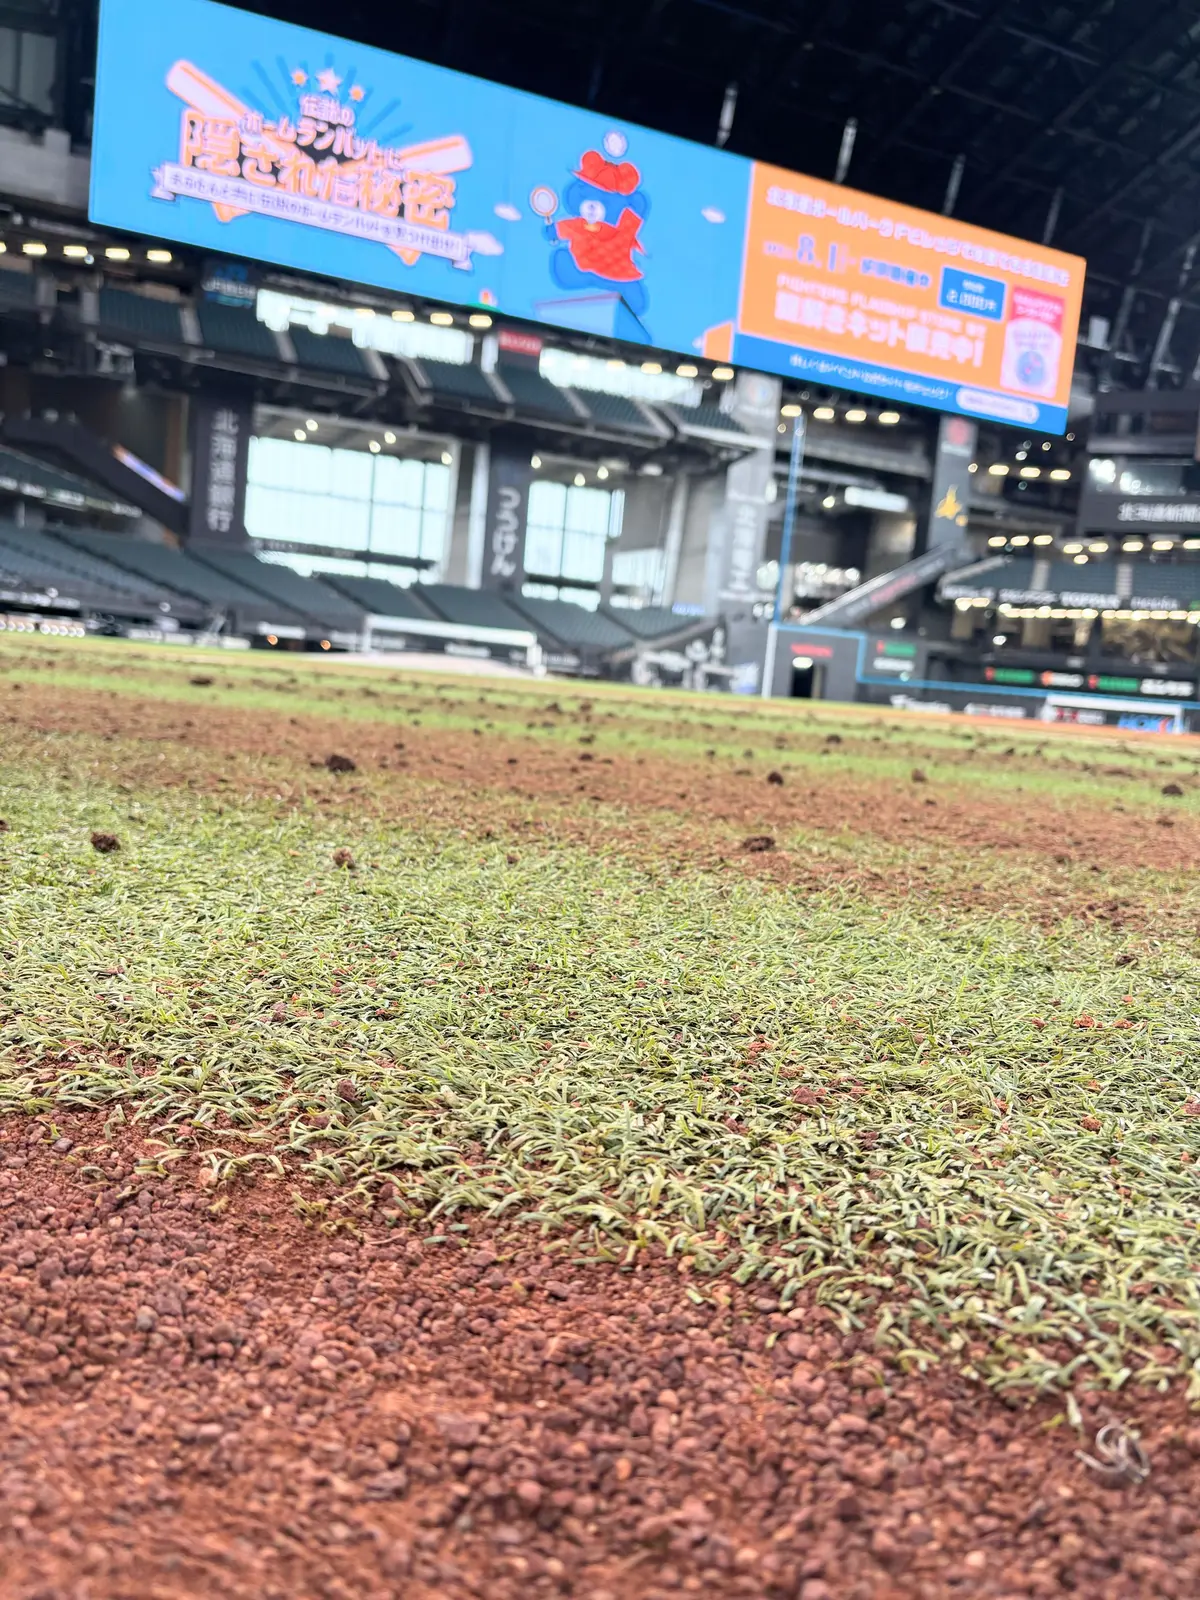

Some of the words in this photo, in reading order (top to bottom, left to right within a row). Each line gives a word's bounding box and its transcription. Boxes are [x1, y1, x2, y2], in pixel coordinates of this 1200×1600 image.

[302, 94, 354, 126] 伝説の
[182, 109, 455, 231] 隠された秘密
[240, 112, 403, 170] ホームランバットに
